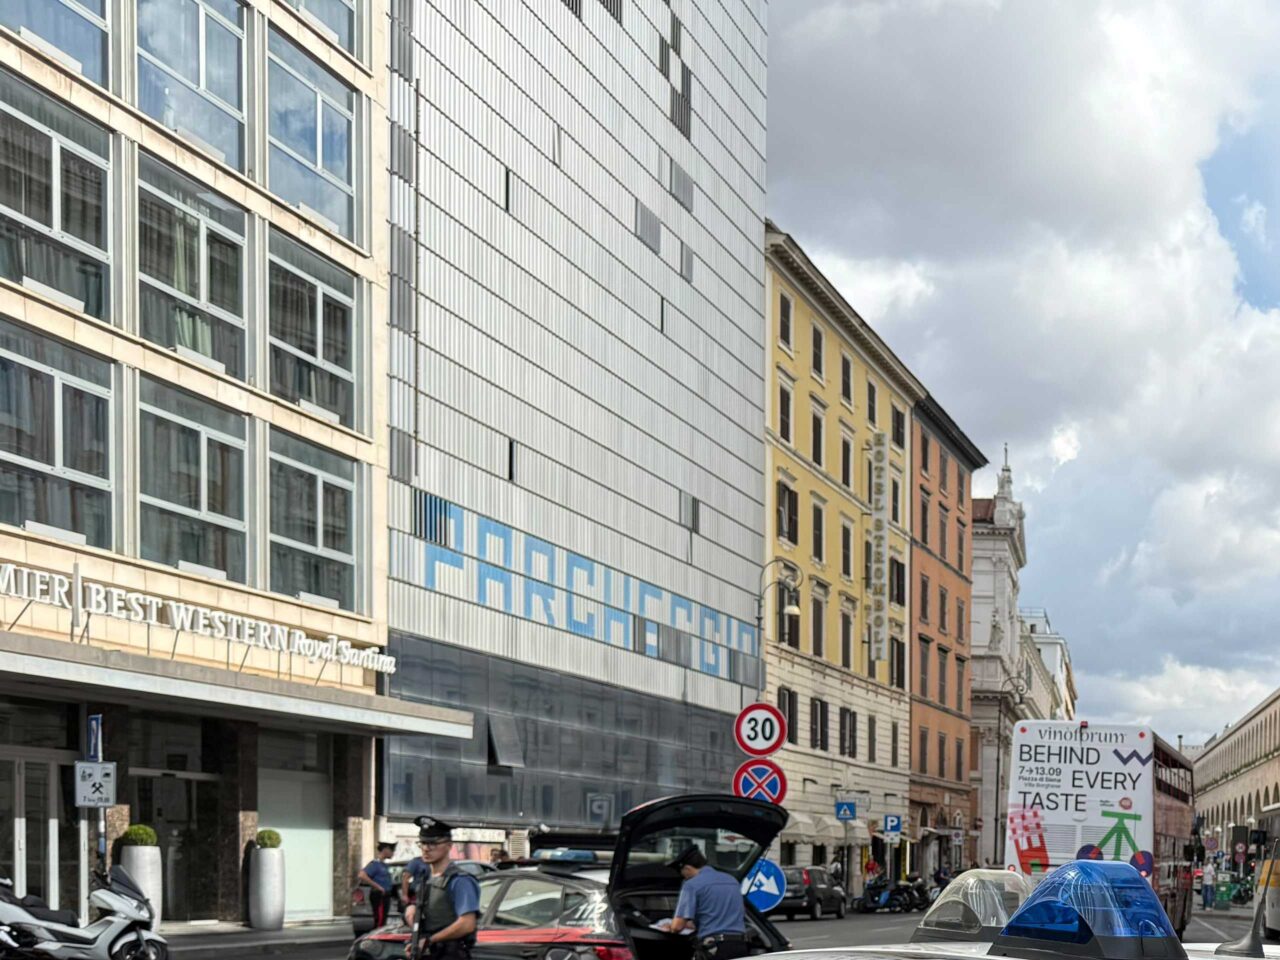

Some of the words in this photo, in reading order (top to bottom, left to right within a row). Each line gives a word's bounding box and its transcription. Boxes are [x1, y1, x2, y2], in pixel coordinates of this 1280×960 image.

[873, 432, 886, 512] HOTEL
[873, 519, 887, 660] STROMBOLI
[86, 582, 163, 625] BEST
[169, 601, 291, 652] WESTERN
[291, 628, 339, 664] Royal
[339, 640, 396, 674] Santina
[746, 717, 775, 742] 30
[1019, 744, 1100, 765] BEHIND
[1072, 770, 1142, 791] EVERY
[1018, 791, 1087, 812] TASTE
[887, 816, 898, 831] P
